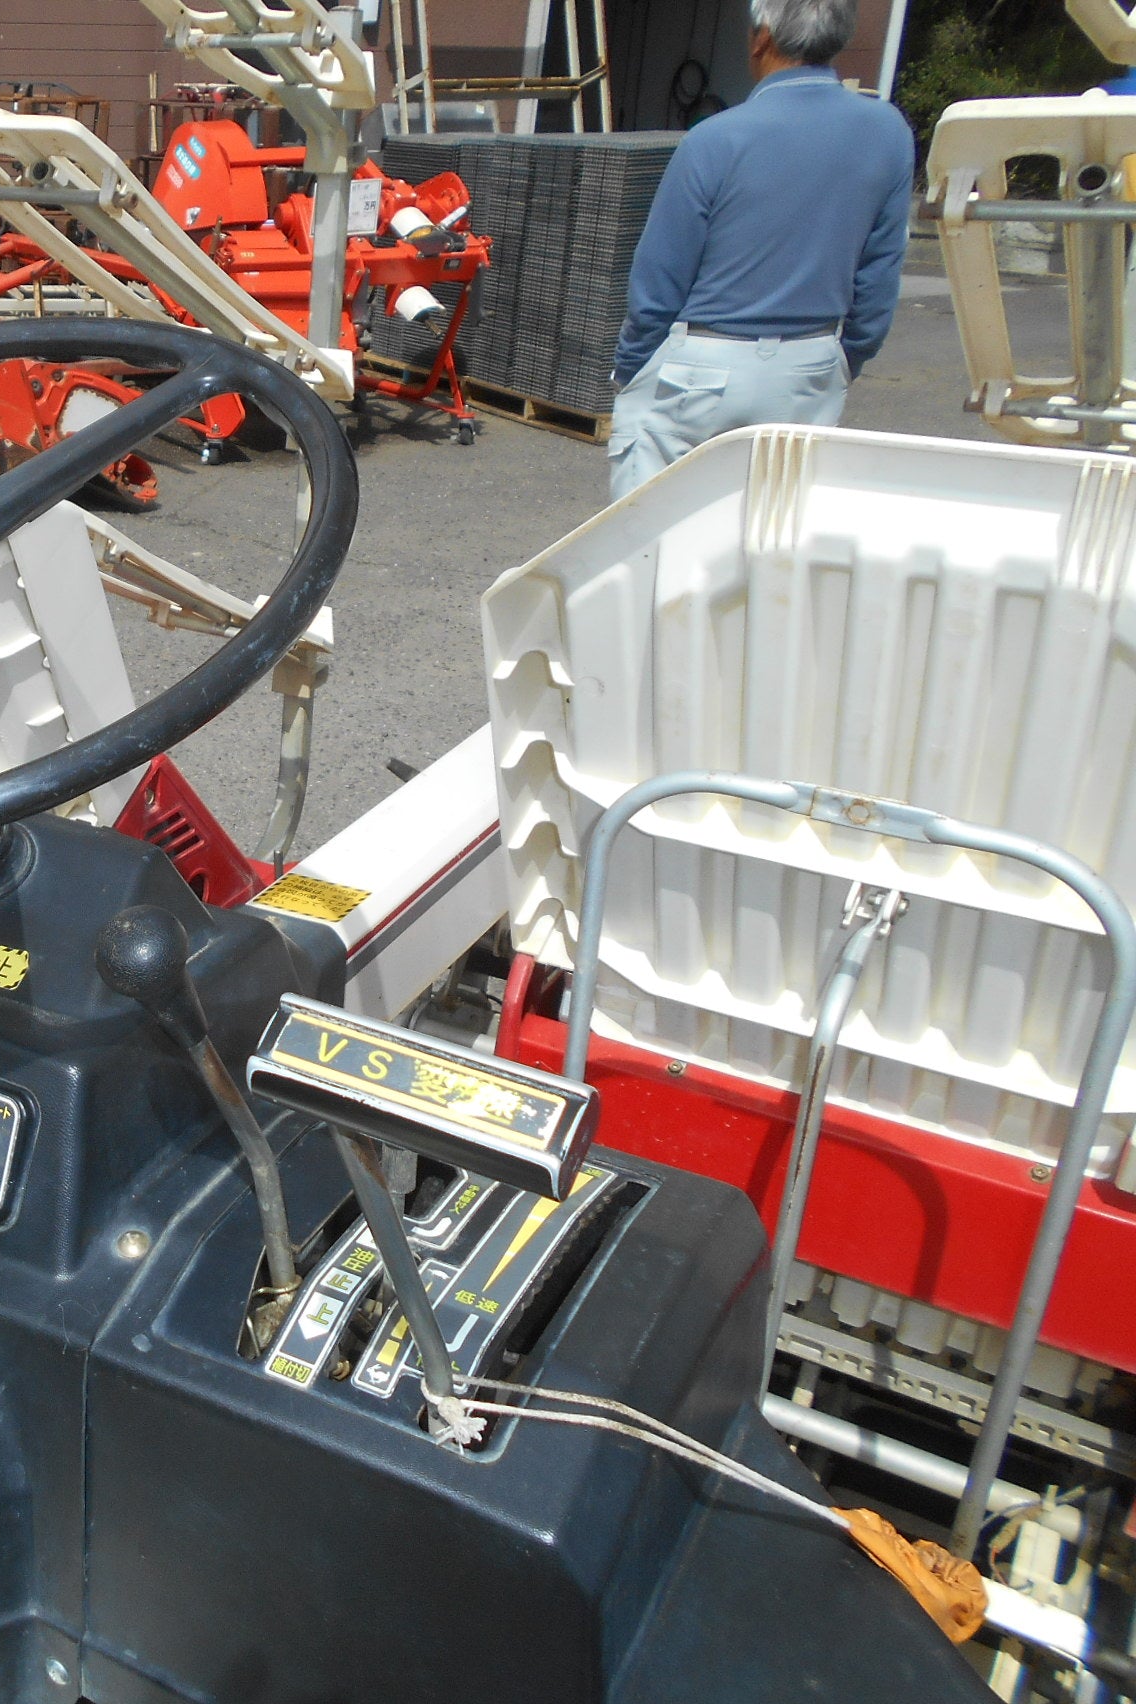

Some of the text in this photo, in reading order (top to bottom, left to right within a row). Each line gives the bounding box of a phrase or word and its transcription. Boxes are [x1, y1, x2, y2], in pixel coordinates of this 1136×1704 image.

[341, 1247, 376, 1273] 油圧
[326, 1273, 353, 1291] 止
[306, 1302, 333, 1326] 上
[455, 1289, 500, 1314] 低速
[271, 1355, 313, 1385] 植付切
